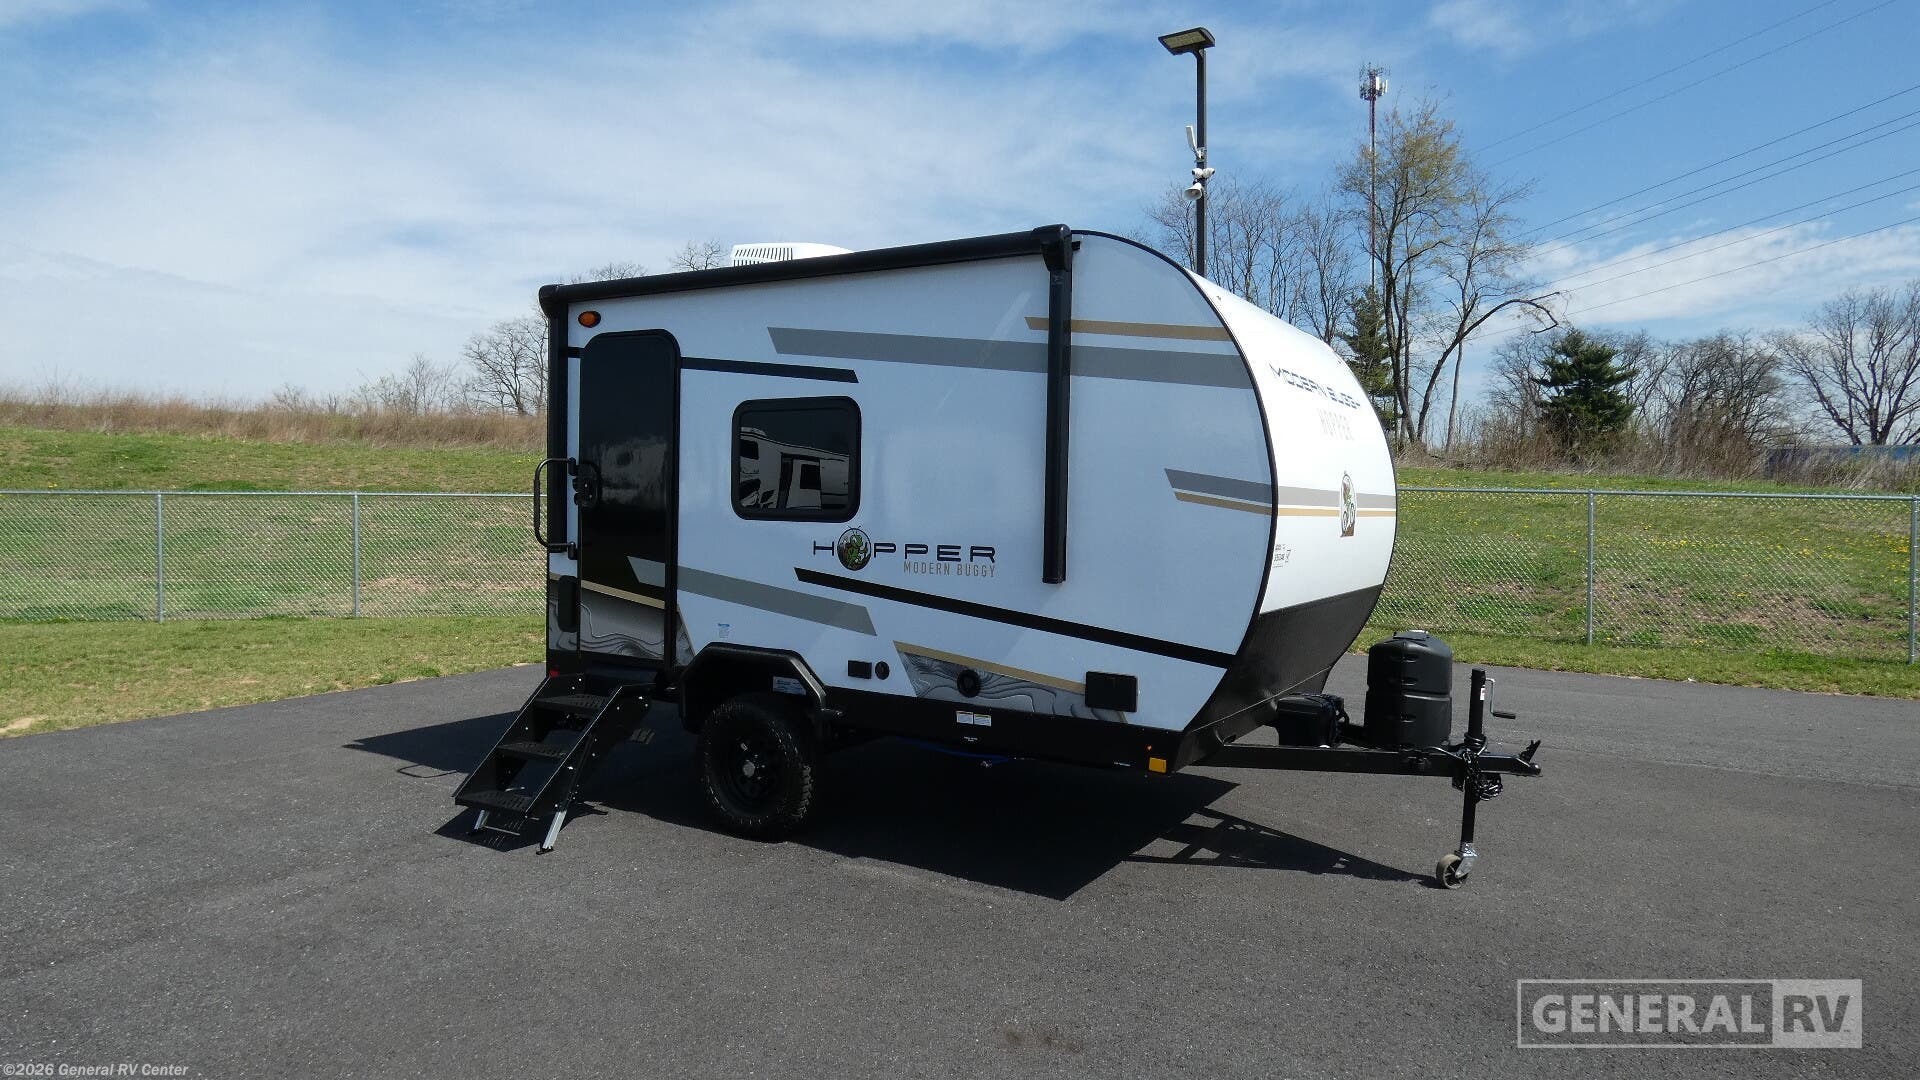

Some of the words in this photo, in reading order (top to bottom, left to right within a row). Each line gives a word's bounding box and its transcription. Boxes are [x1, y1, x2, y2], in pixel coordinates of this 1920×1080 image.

[812, 529, 996, 570] HOPPER
[903, 561, 950, 576] MODERN
[956, 562, 996, 578] BUGGY
